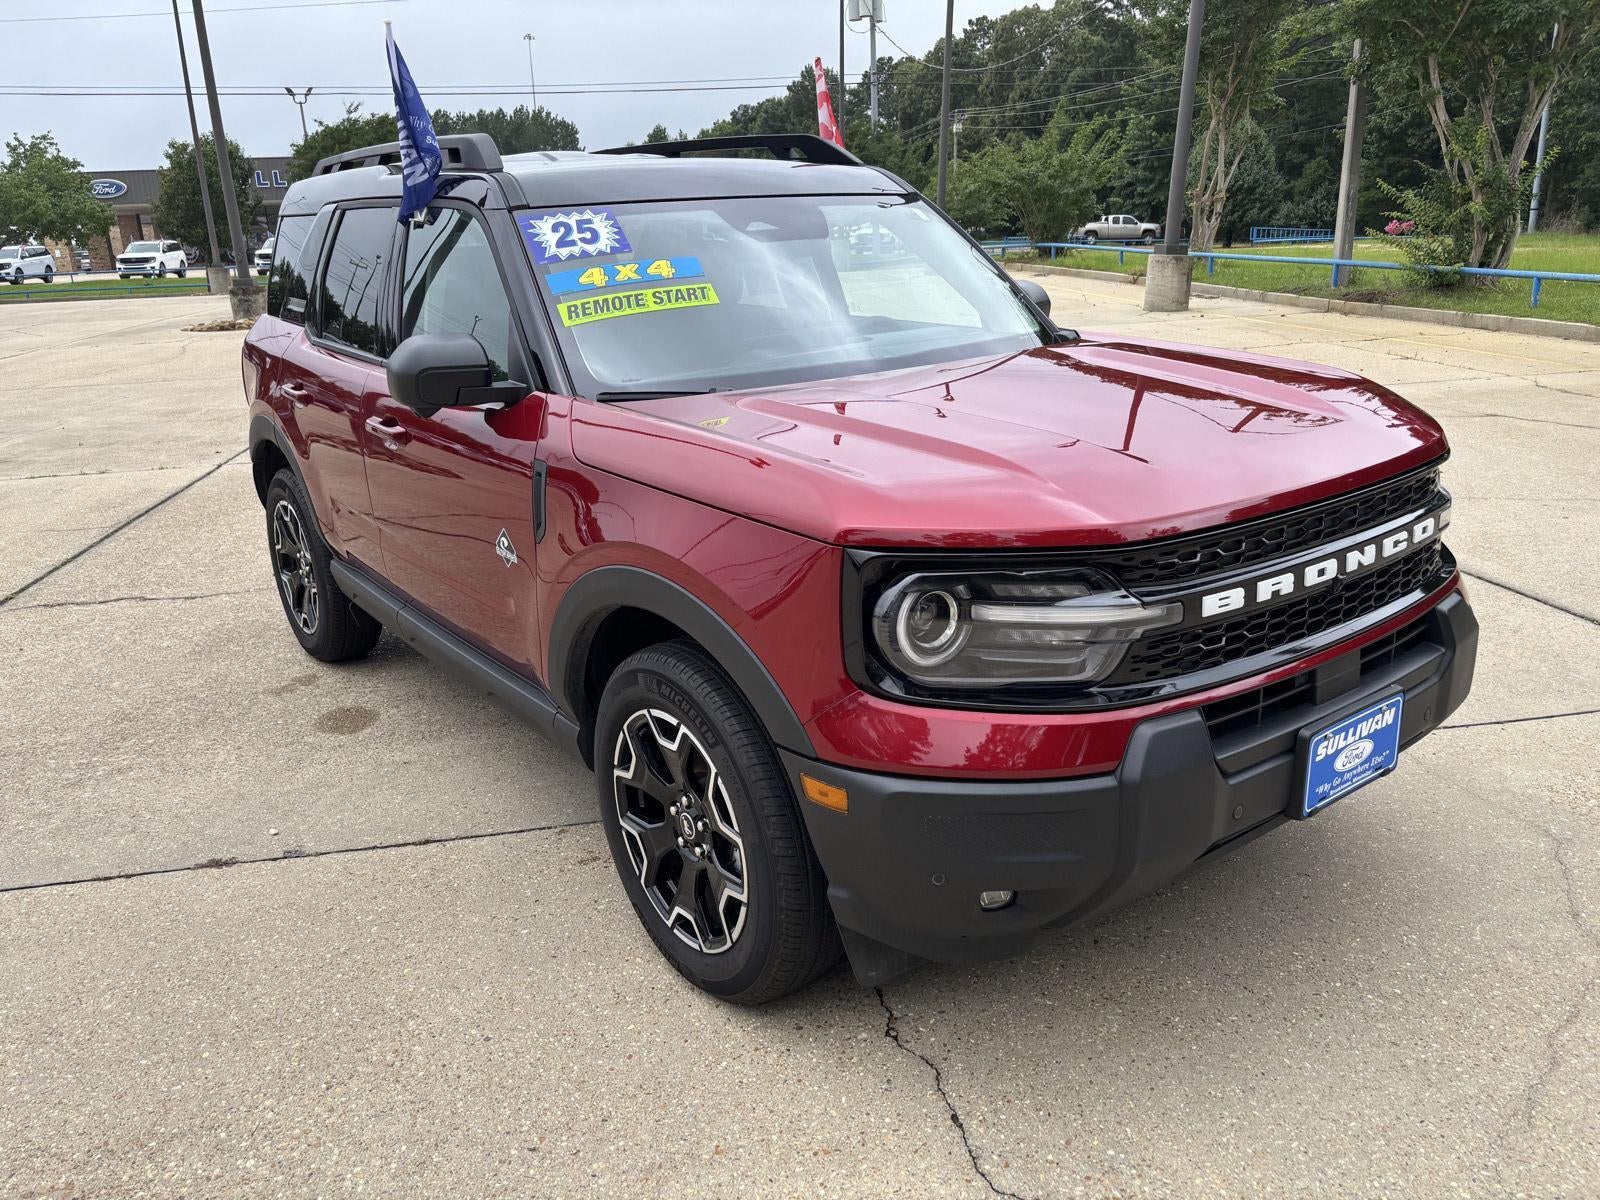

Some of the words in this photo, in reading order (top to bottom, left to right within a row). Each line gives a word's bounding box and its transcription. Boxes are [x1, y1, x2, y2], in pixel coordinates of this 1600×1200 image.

[551, 218, 601, 250] 25
[578, 266, 609, 287] 4
[646, 259, 676, 278] 4
[566, 292, 648, 322] REMOTE
[652, 286, 710, 306] START
[1201, 517, 1435, 618] BRONCO
[660, 684, 717, 746] MICHELIN
[1315, 707, 1396, 762] SULLIVAN
[1342, 746, 1366, 767] Ford
[1332, 776, 1342, 786] Go
[1342, 762, 1370, 783] Anywhere
